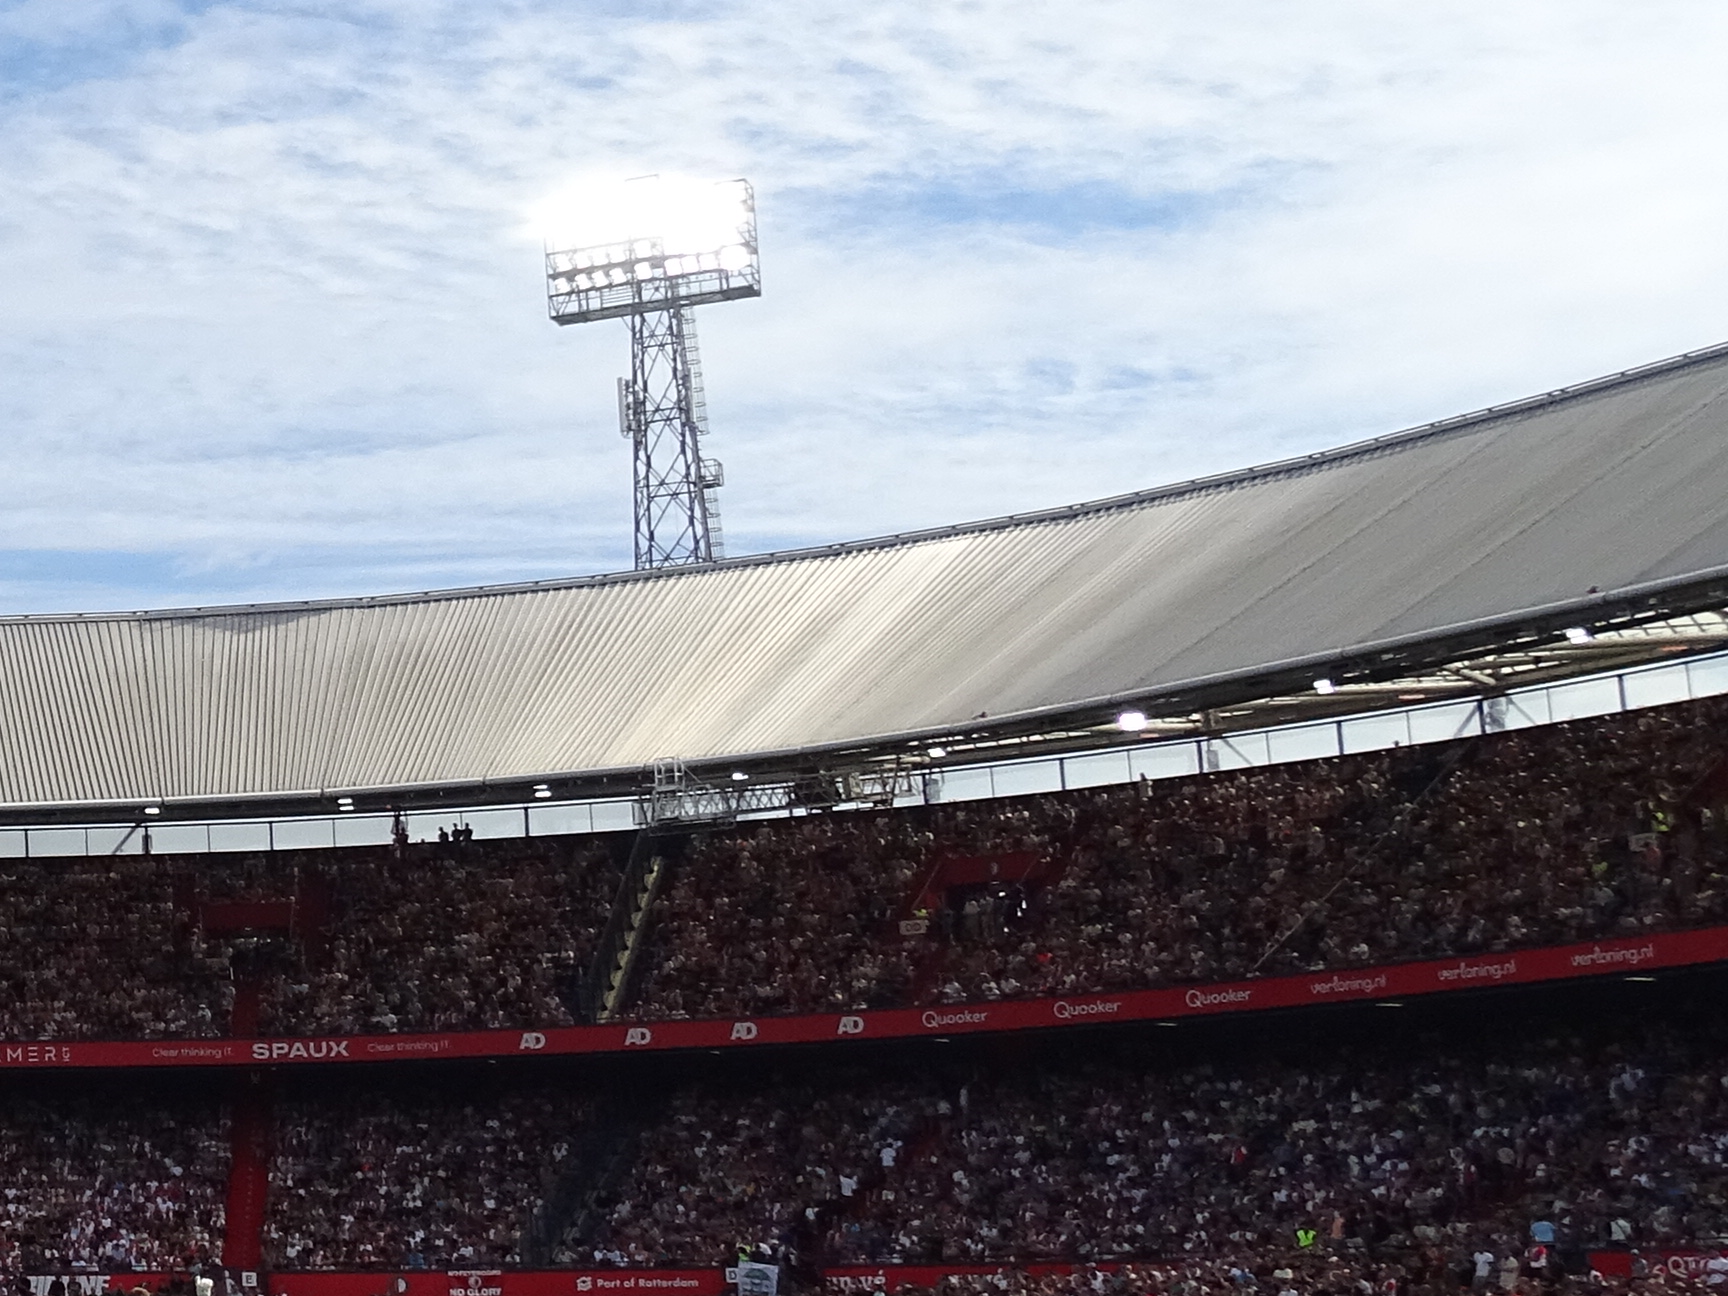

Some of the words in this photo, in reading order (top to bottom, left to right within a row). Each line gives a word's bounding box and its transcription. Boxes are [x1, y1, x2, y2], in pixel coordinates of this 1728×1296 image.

[1186, 989, 1252, 1008] Quooker
[1053, 1001, 1122, 1018] Quooker
[837, 1016, 864, 1035] AD
[922, 1010, 988, 1029] Quooker
[624, 1027, 651, 1046] AD
[730, 1022, 758, 1040] AD
[251, 1041, 349, 1059] SPAUX
[519, 1032, 546, 1050] AD
[181, 1046, 222, 1058] thinking
[619, 1277, 635, 1288] of
[639, 1277, 699, 1288] Rotterdam
